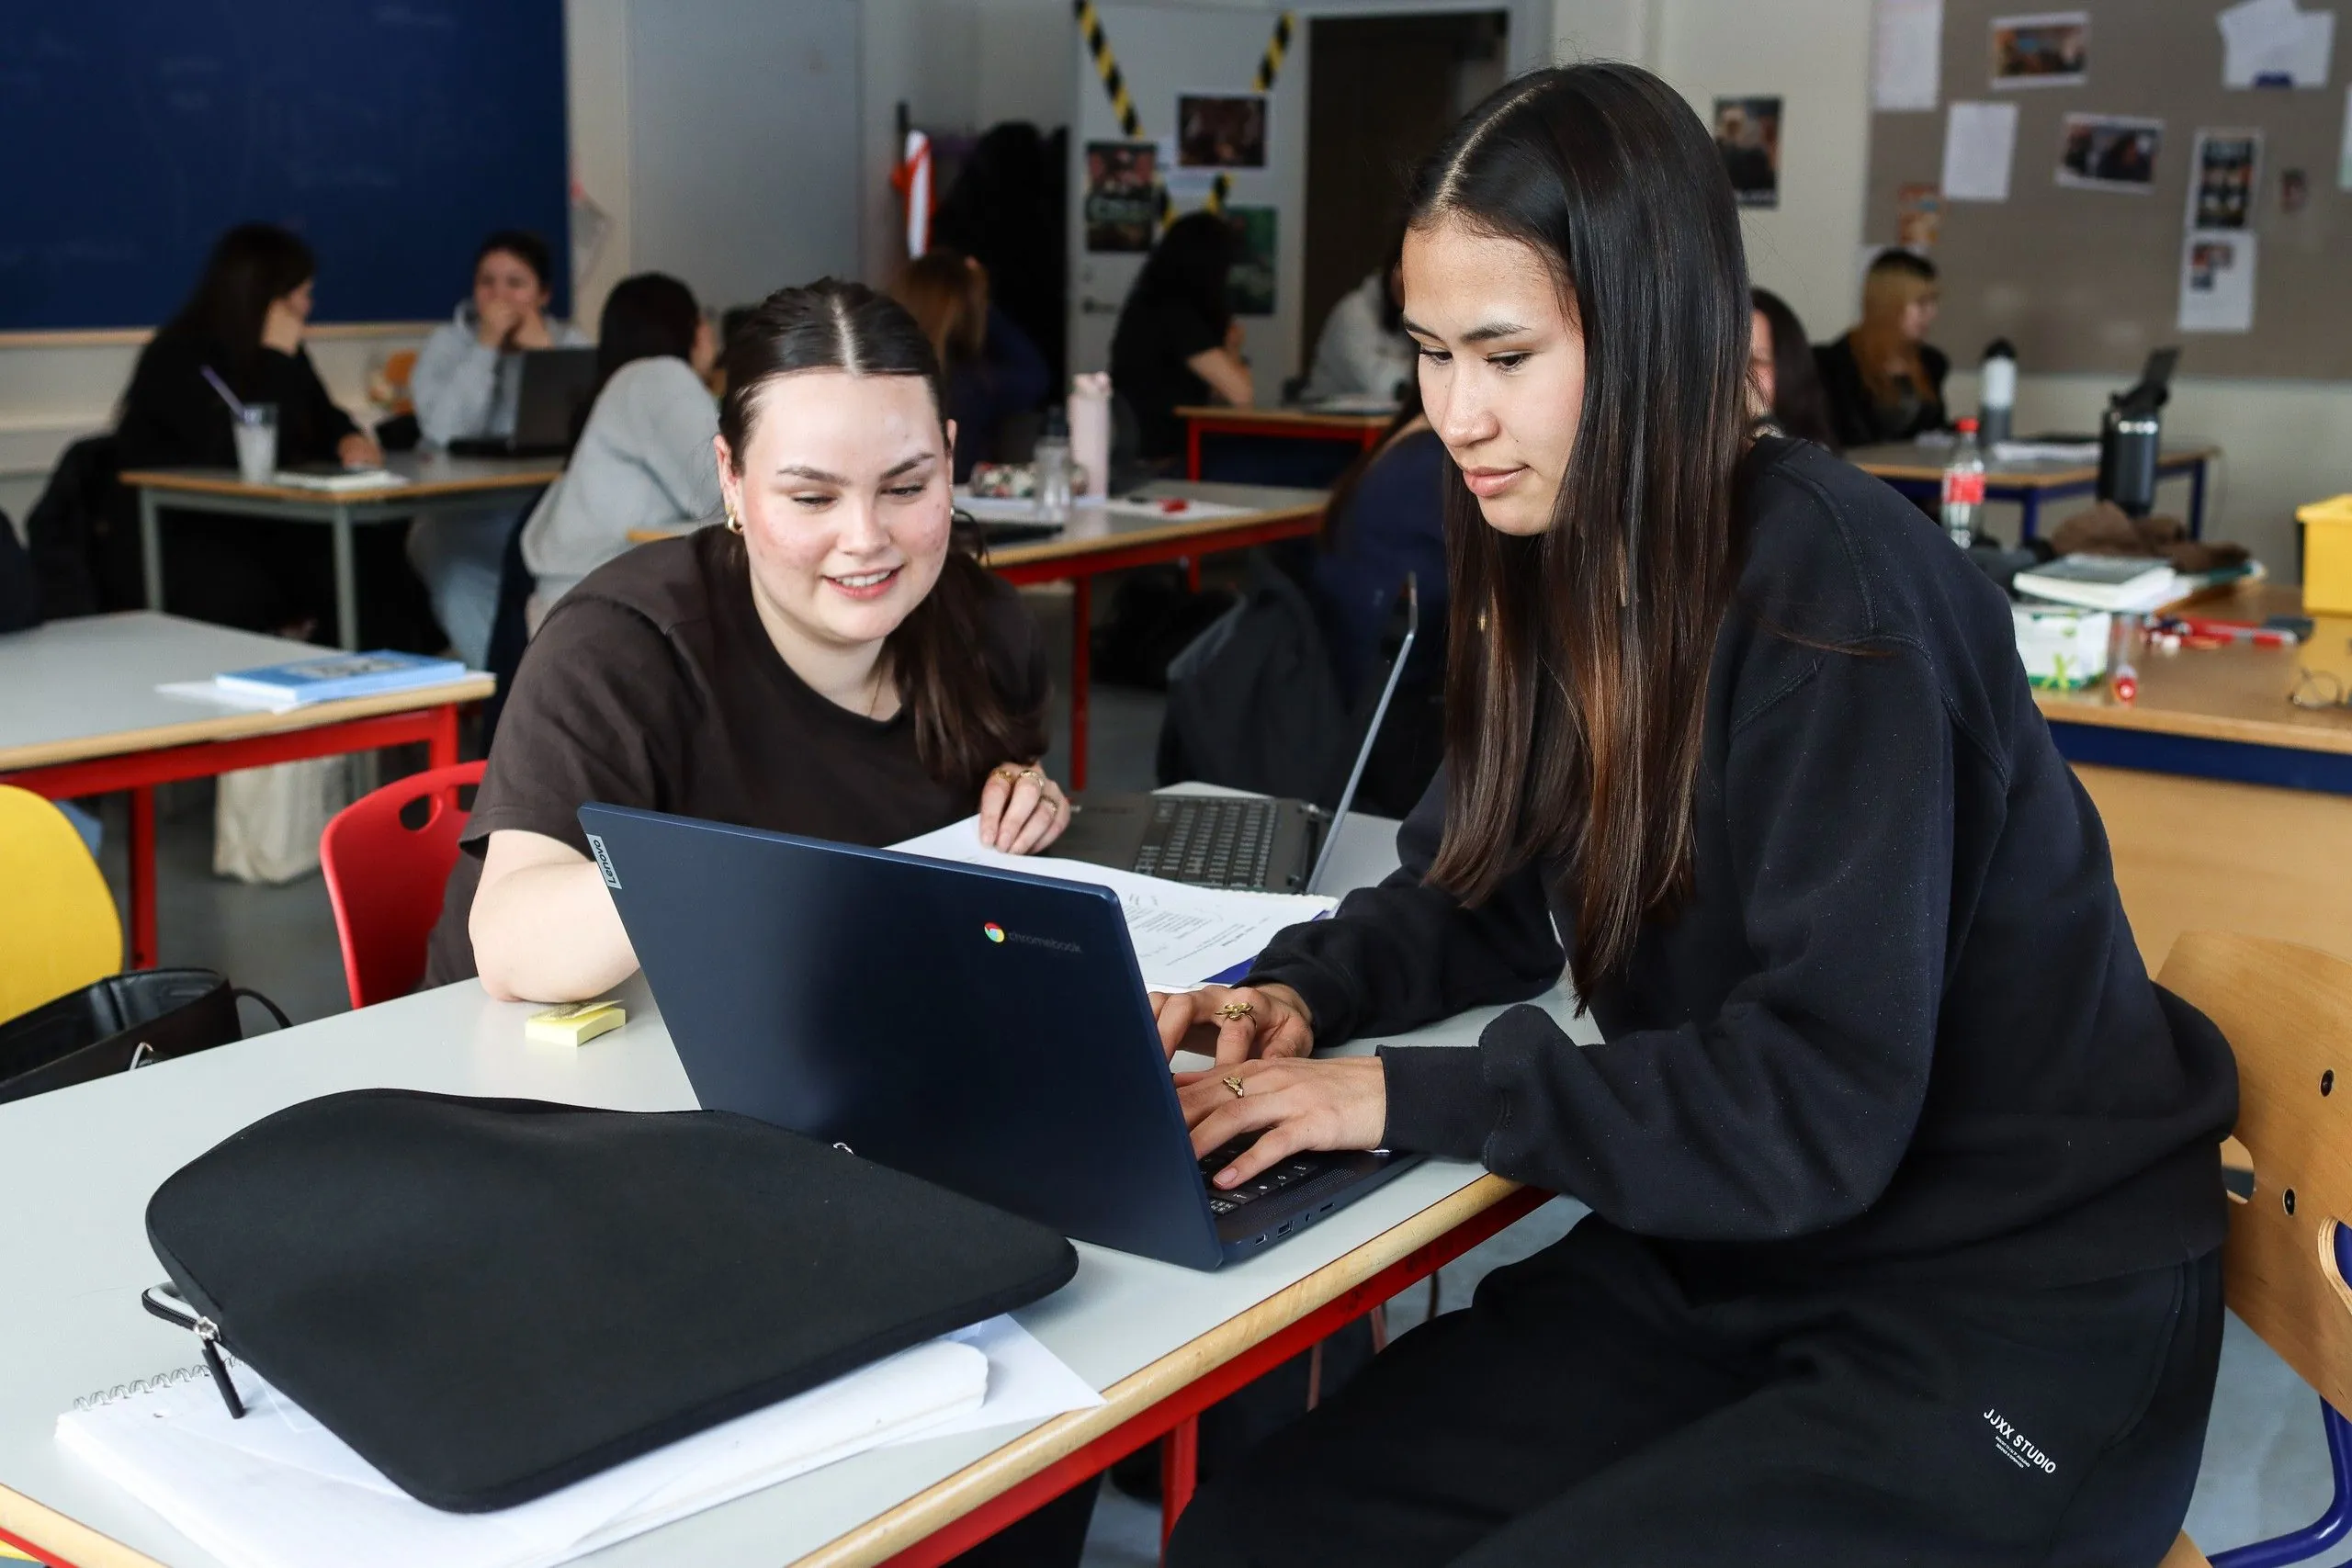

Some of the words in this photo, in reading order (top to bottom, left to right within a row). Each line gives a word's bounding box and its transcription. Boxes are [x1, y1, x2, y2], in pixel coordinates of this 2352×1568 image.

[593, 839, 616, 884] Lenovo
[1983, 1408, 2015, 1439] JJXX
[2013, 1435, 2056, 1473] STUDIO
